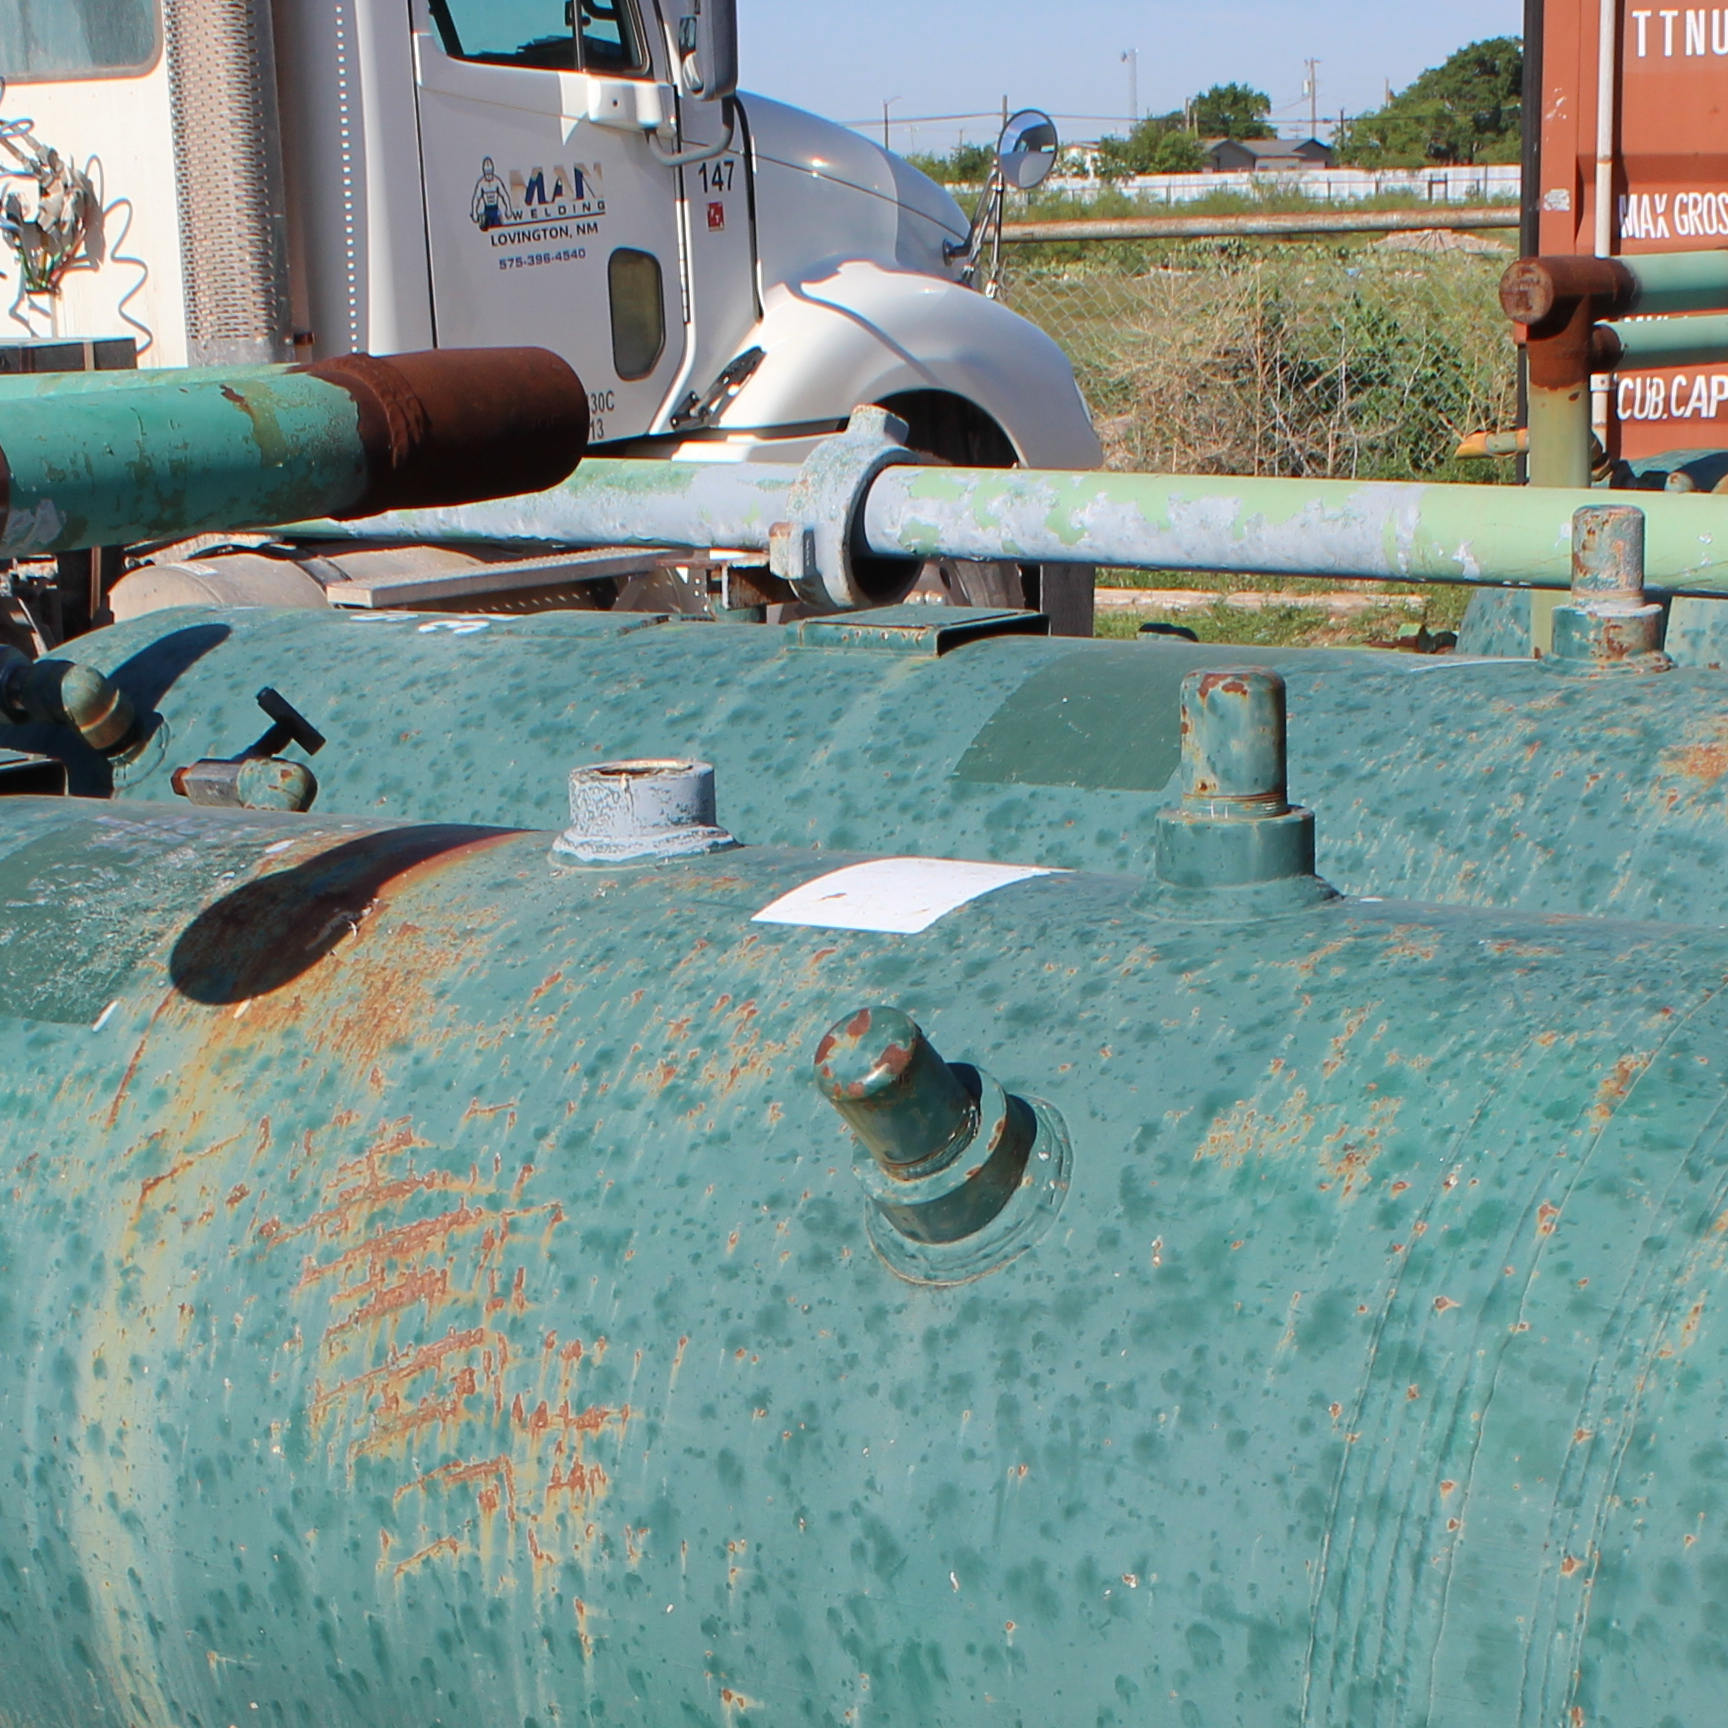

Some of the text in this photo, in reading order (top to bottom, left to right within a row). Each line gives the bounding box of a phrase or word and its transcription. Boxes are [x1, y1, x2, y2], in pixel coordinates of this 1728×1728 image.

[509, 162, 604, 207] MAN
[698, 160, 735, 193] 147
[512, 200, 606, 221] WELDING
[1618, 192, 1670, 238] MAX
[490, 222, 599, 247] LOVINGTON, NM
[498, 247, 587, 270] 575-396-4540
